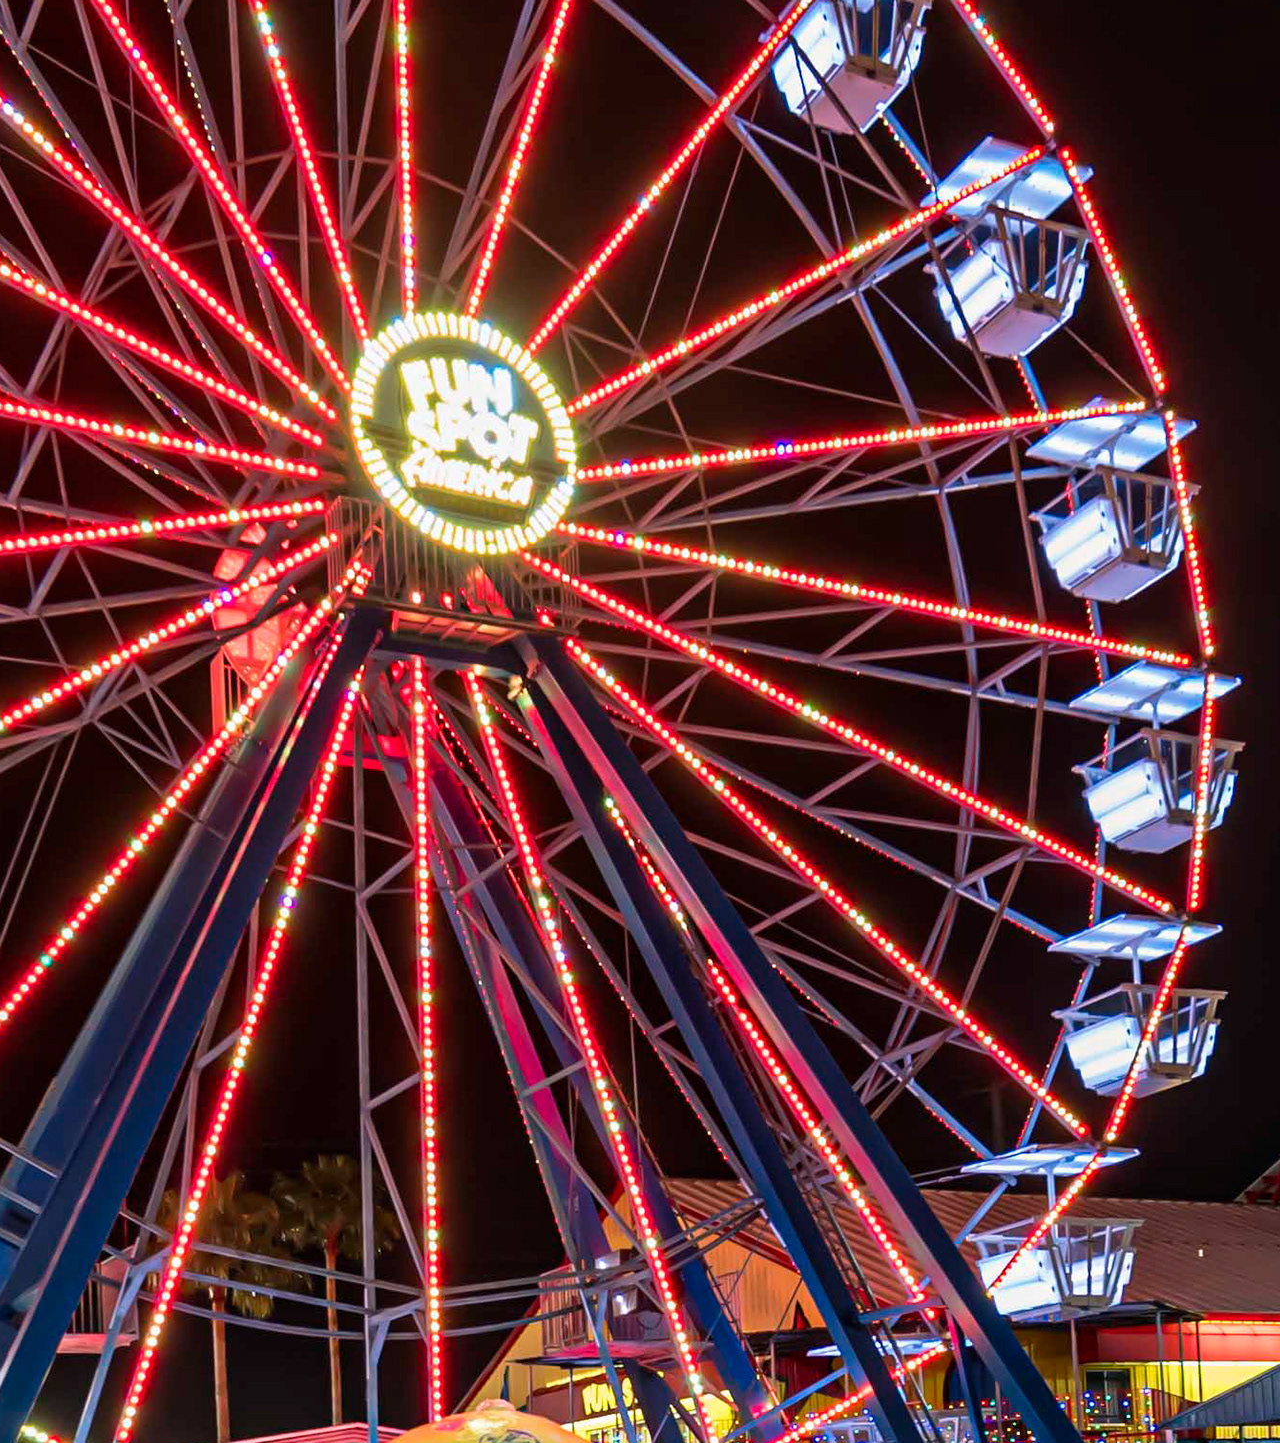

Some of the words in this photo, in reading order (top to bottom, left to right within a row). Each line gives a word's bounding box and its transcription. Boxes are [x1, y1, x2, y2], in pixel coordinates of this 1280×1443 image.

[401, 356, 514, 416] FUN
[407, 405, 539, 464] SPOT
[400, 442, 534, 506] AMERICA
